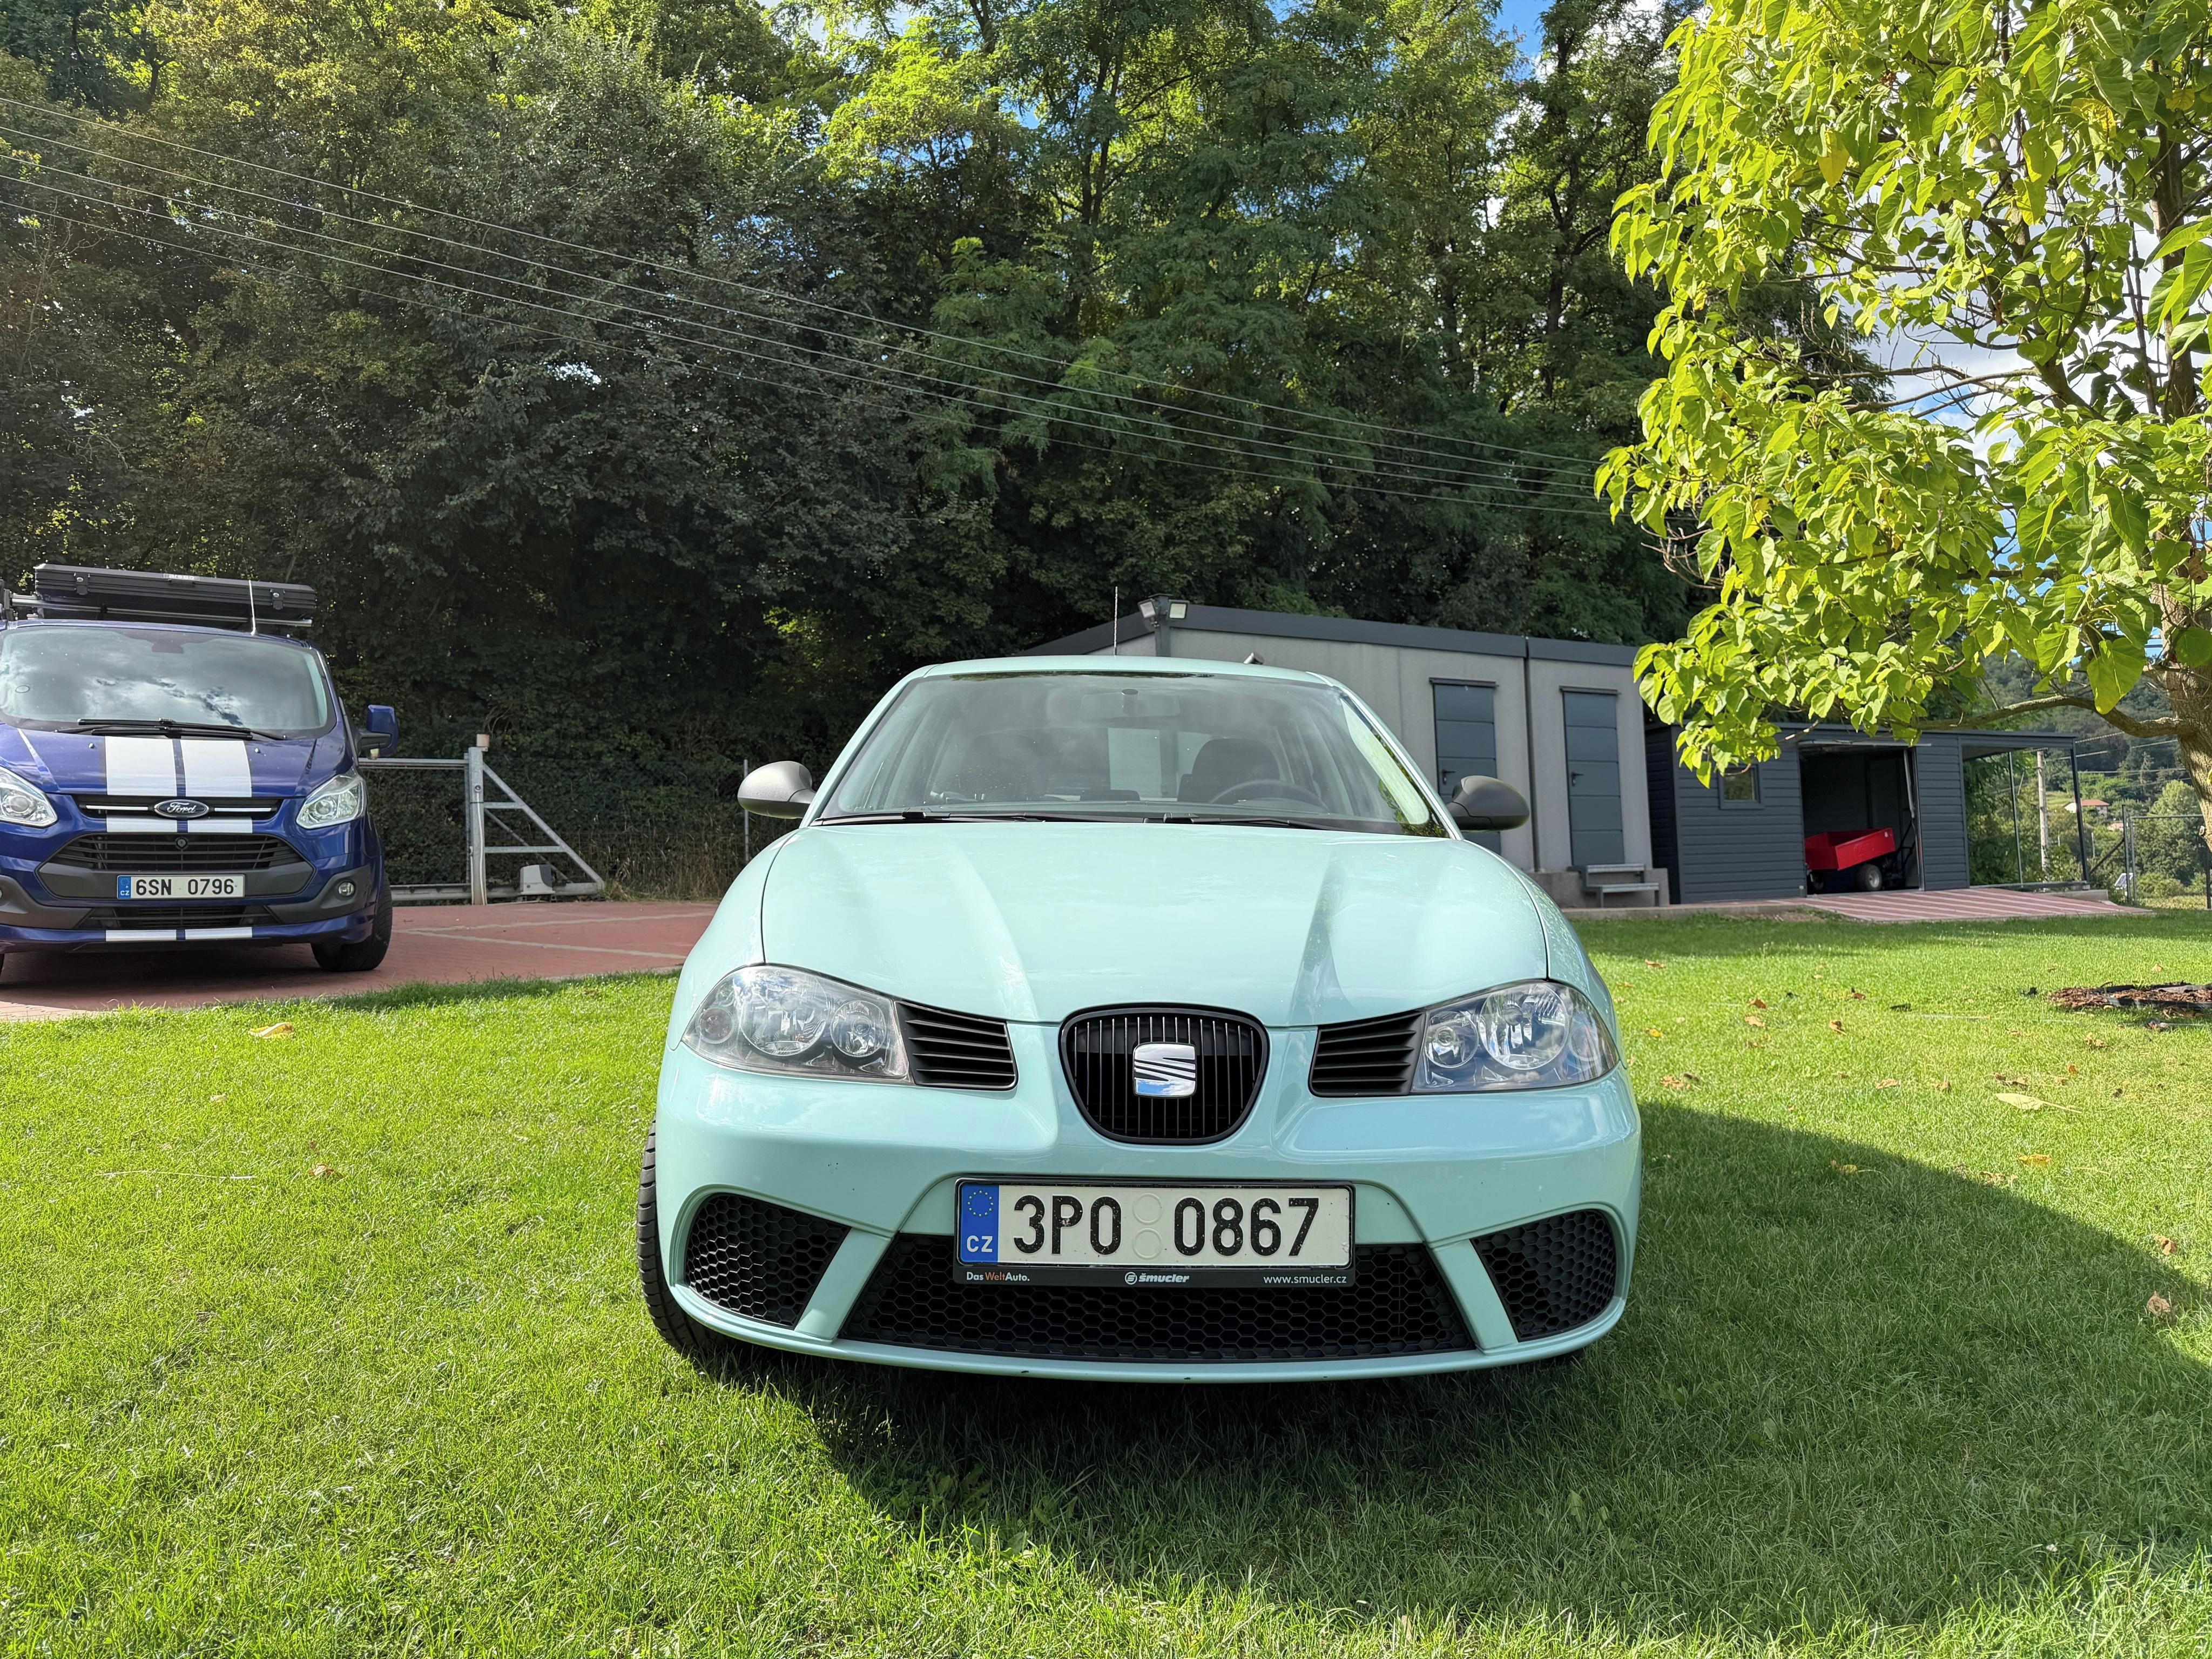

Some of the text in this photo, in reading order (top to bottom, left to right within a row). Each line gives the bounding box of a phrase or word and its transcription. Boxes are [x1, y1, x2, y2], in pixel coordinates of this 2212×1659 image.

[167, 802, 197, 813] Ford
[136, 879, 172, 896] 6SN
[187, 878, 234, 895] 0796
[966, 1195, 1319, 1257] CZ 3P0 0867
[966, 1271, 984, 1280] Das
[1138, 1273, 1190, 1283] šmucler
[1263, 1274, 1347, 1284] www.smucler.cz
